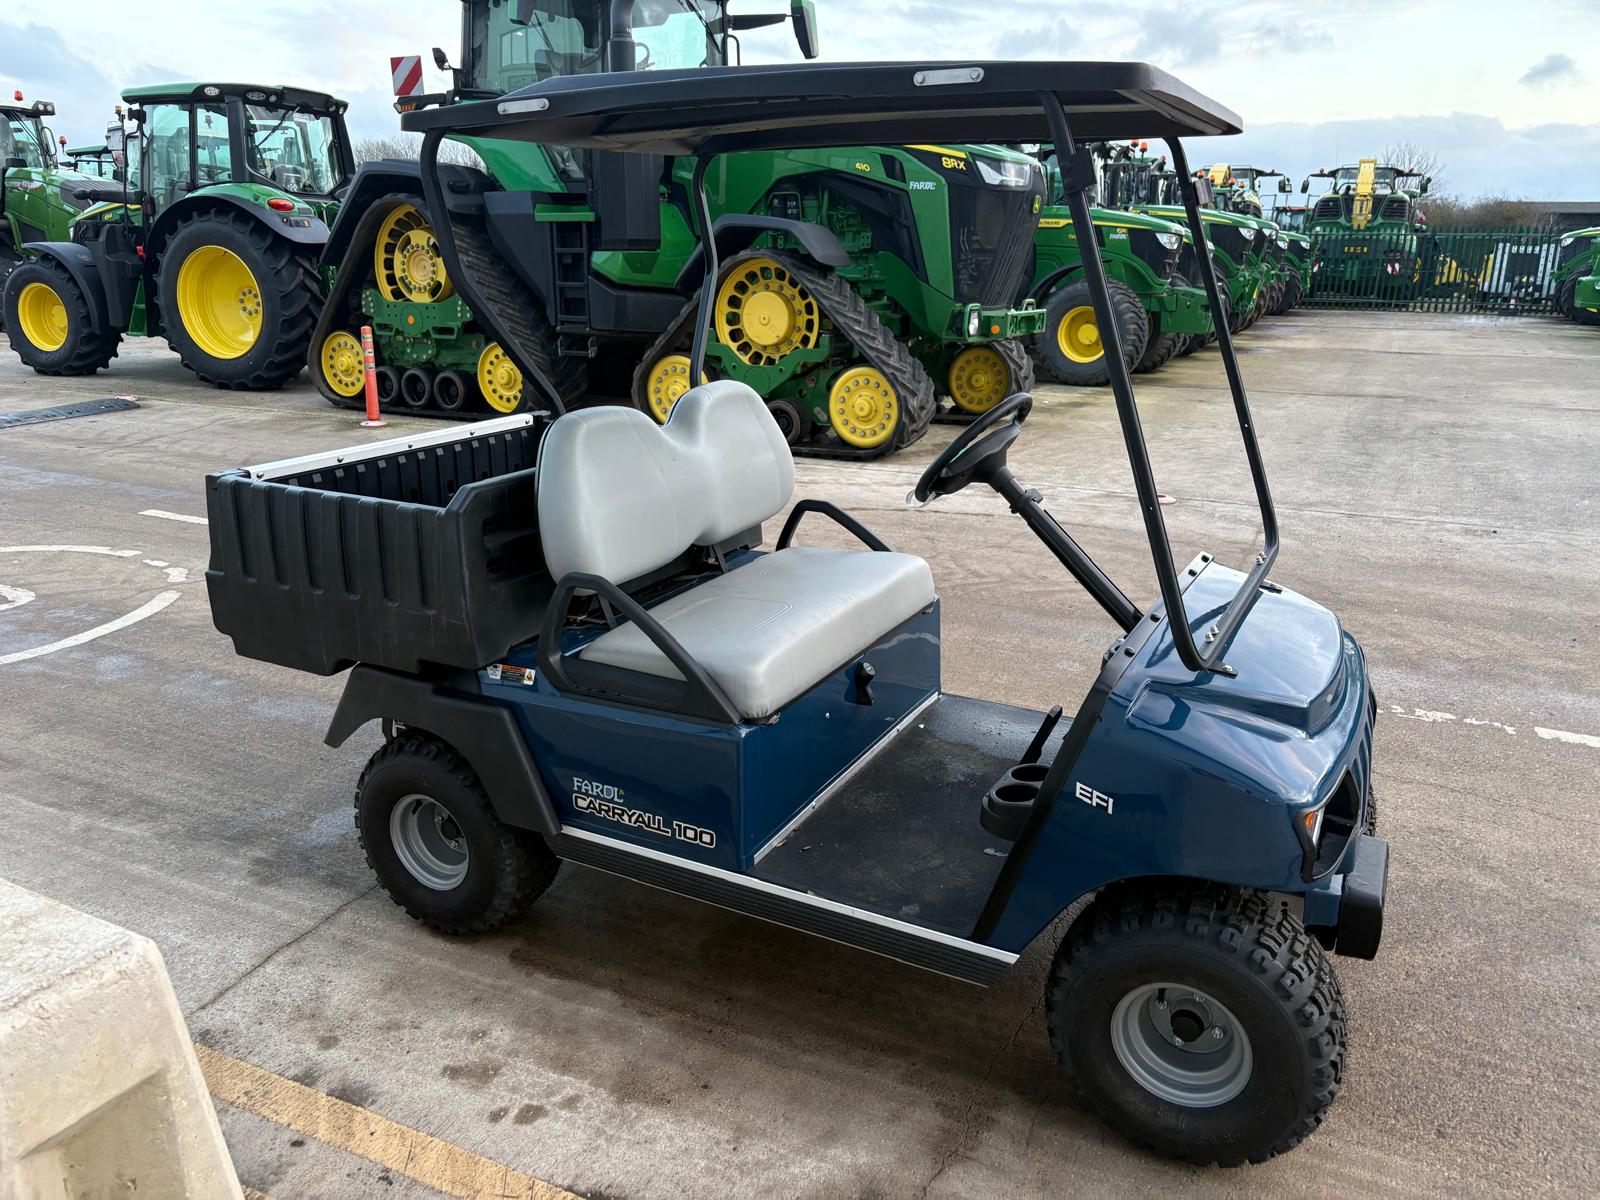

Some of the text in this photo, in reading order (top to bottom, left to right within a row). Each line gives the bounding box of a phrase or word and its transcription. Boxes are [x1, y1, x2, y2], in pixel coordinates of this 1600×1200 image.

[855, 162, 871, 172] 410
[941, 156, 967, 171] 8RX
[909, 181, 936, 190] FAROL
[572, 776, 624, 803] FAROL
[1075, 781, 1114, 815] EFI
[572, 793, 716, 848] CARRYALL 100
